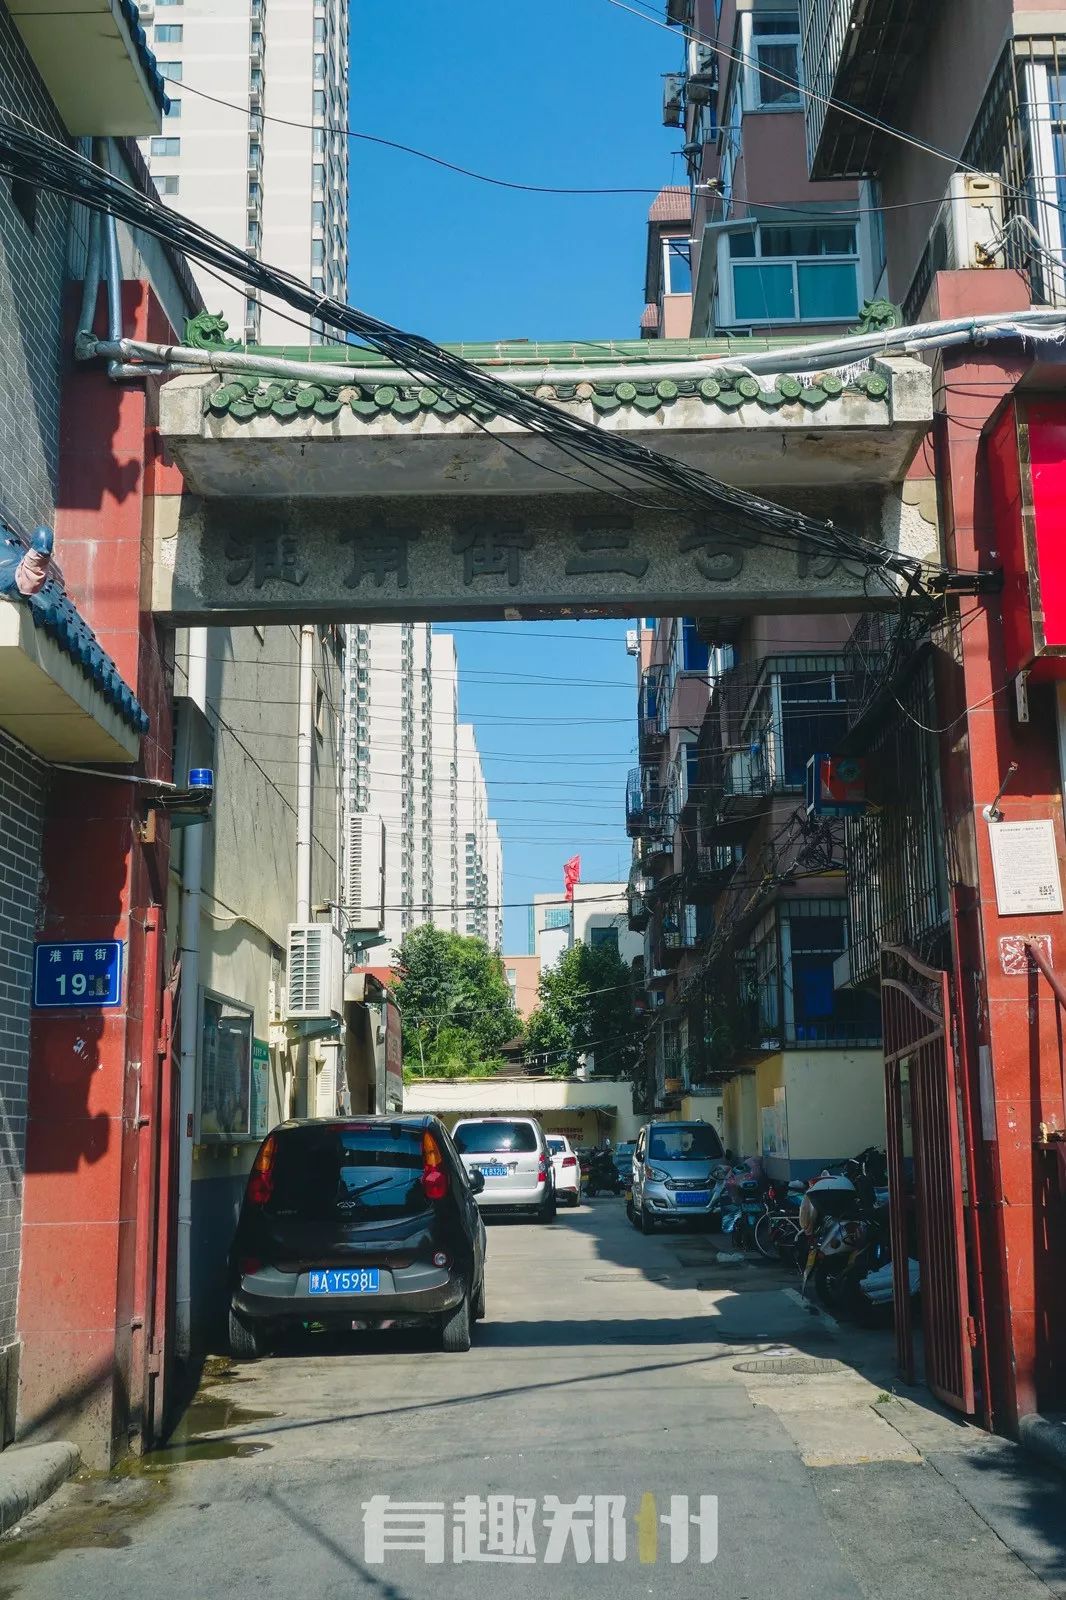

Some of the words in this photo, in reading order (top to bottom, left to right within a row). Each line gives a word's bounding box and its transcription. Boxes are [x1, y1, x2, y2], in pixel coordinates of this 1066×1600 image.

[49, 948, 107, 963] 淮南街
[55, 973, 87, 996] 19
